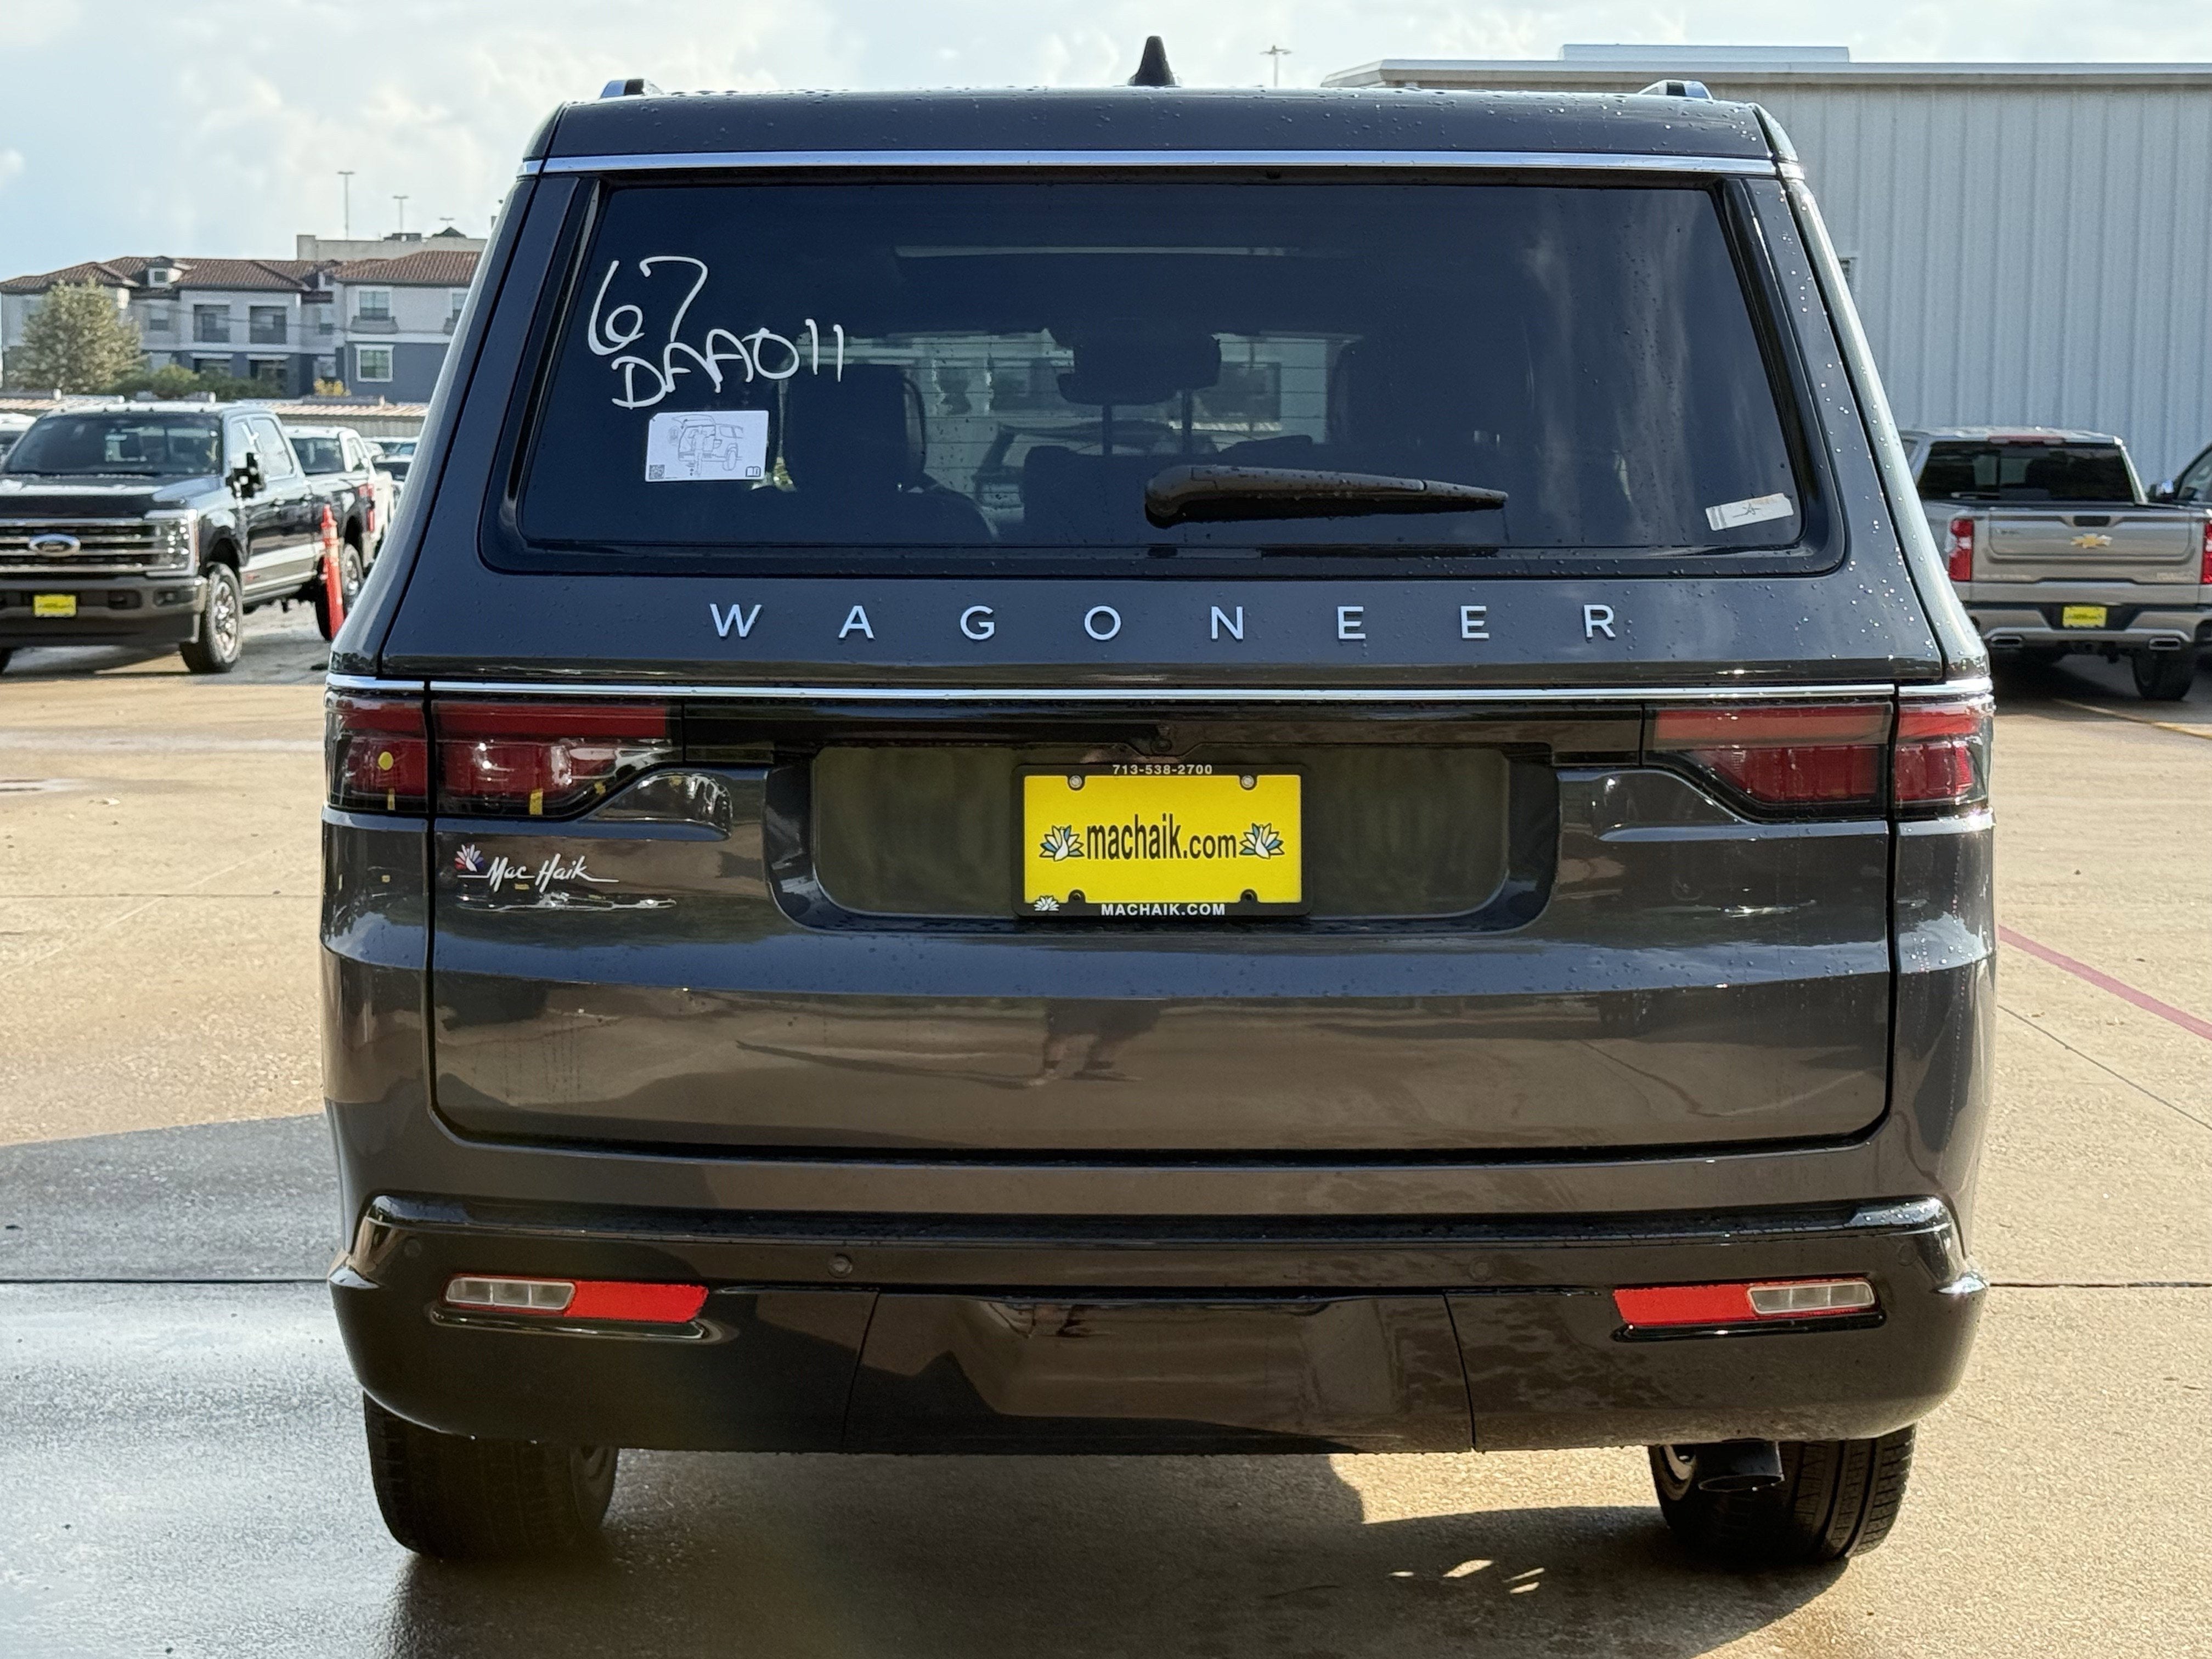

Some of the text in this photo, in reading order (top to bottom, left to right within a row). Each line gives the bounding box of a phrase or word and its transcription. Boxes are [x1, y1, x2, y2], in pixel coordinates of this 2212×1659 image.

[588, 256, 708, 356] 67
[709, 603, 1617, 640] WAGONEER
[1113, 764, 1213, 775] 713-538-2700
[1087, 813, 1237, 860] machaik.com
[464, 853, 616, 893] Mac Haik
[1101, 903, 1226, 916] MACHAIK.COM
